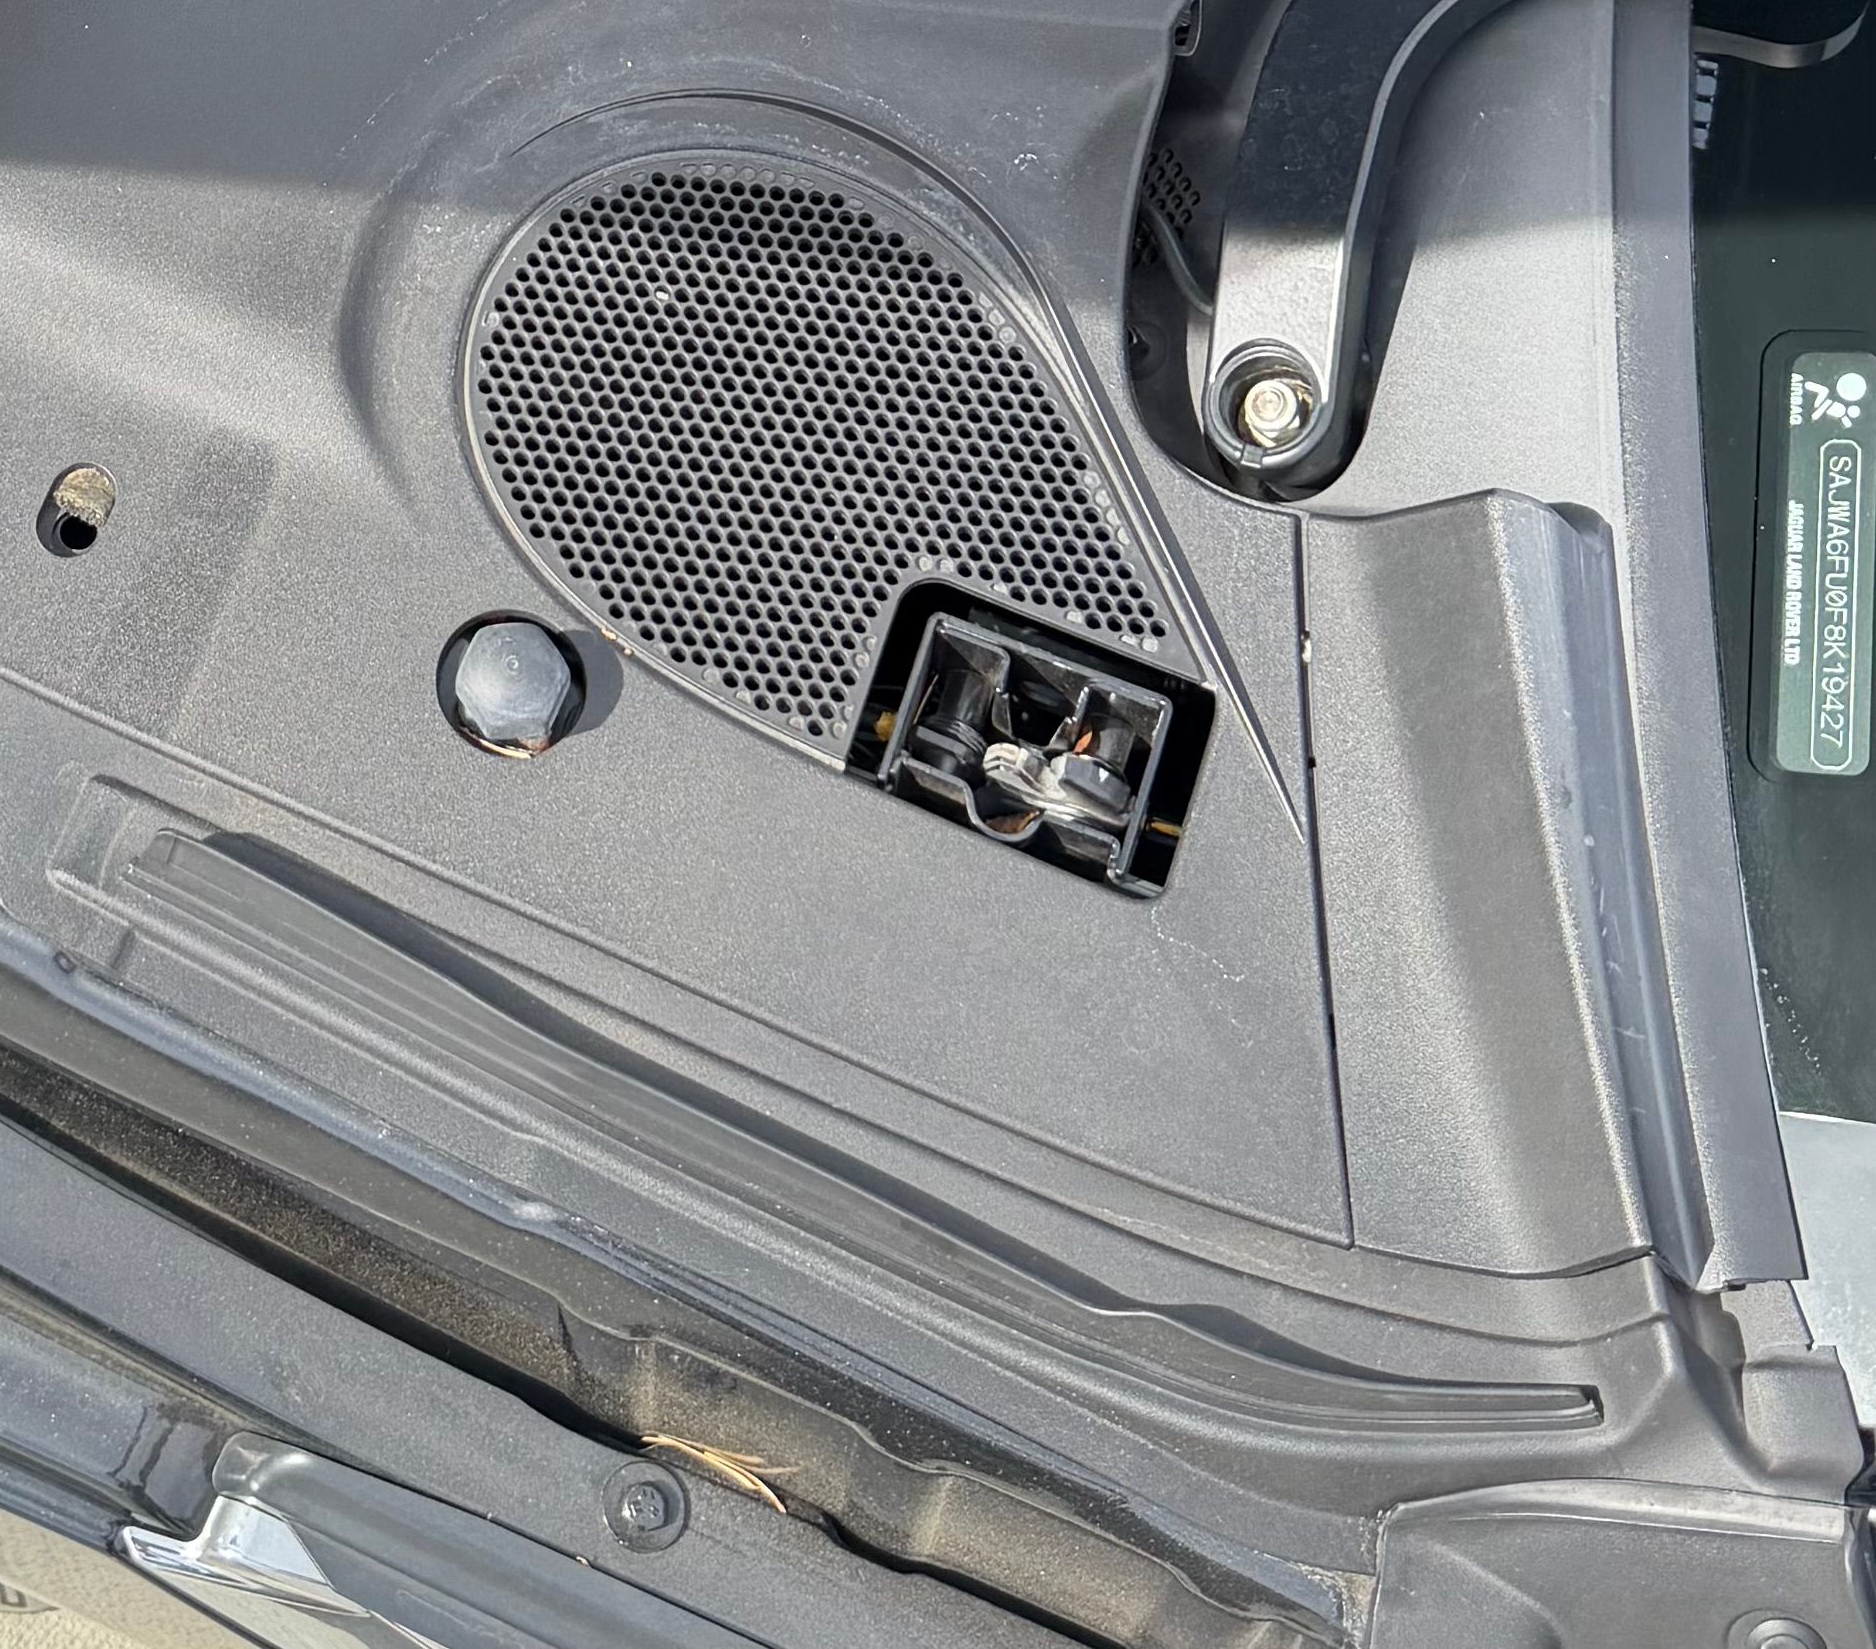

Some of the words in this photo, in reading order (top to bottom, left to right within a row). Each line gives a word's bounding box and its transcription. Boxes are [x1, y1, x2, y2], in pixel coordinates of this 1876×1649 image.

[1790, 372, 1804, 425] AIRBAG
[1787, 500, 1804, 551] JAGUAR
[1786, 554, 1803, 589] LAND
[1785, 592, 1801, 636] ROVER
[1819, 454, 1853, 749] SAJWA6FU0F8K19427
[1784, 639, 1801, 665] LTD
